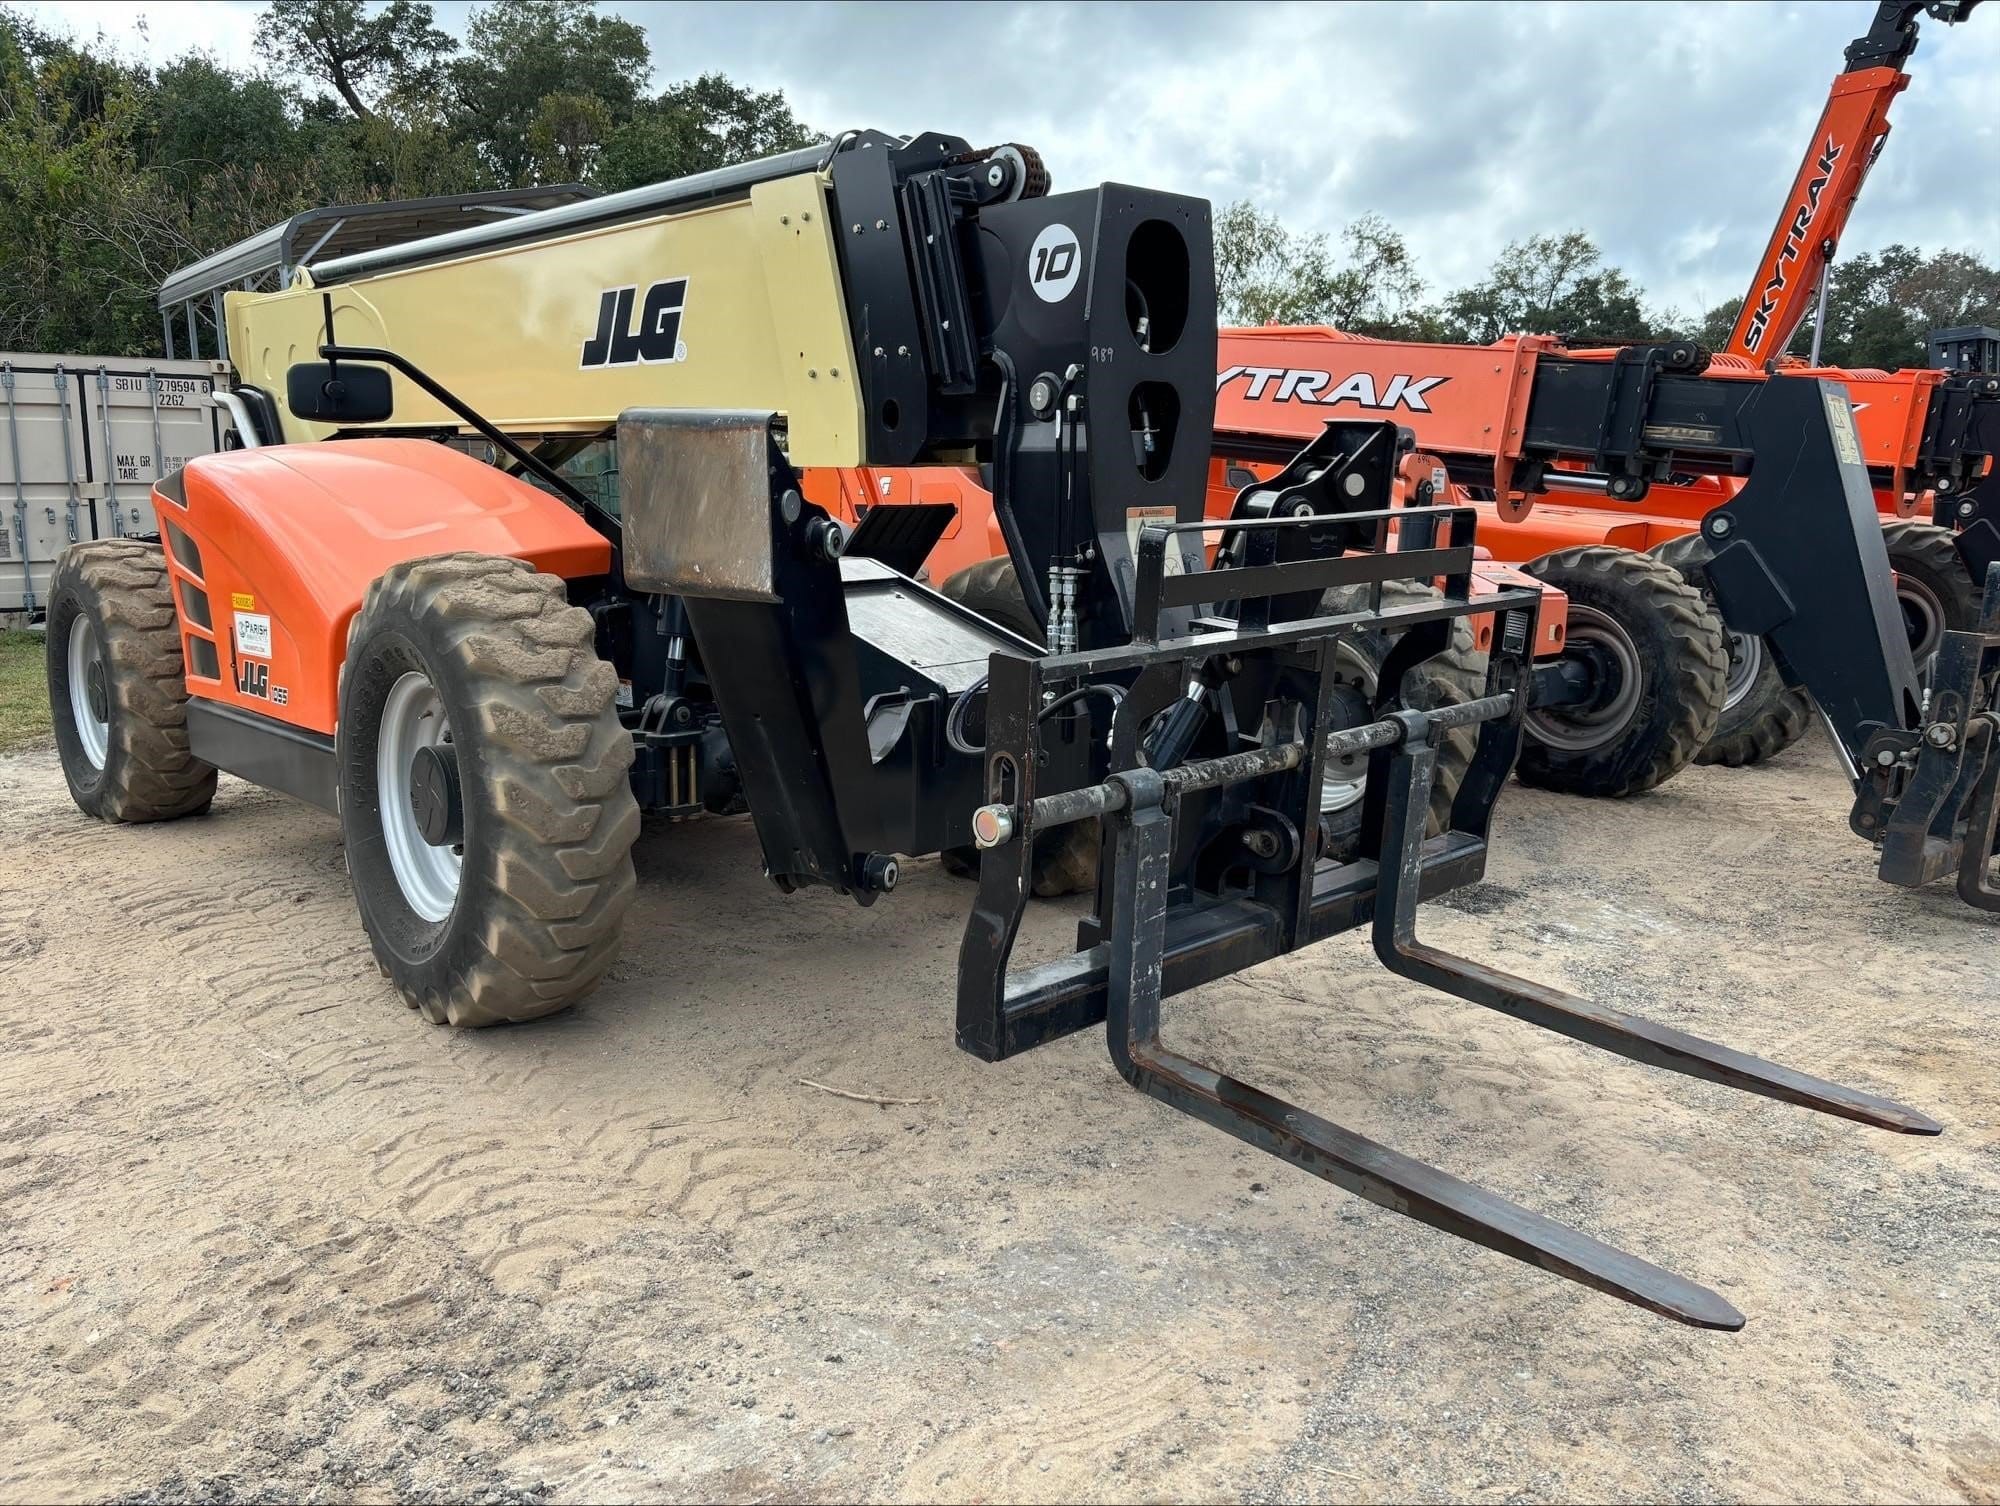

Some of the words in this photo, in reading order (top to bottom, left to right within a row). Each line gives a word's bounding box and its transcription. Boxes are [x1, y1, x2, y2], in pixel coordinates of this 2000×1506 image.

[1744, 133, 1844, 355] SKYTRAK
[1033, 242, 1077, 283] 10
[580, 277, 689, 369] JLG
[1091, 346, 1114, 362] 989
[115, 378, 142, 391] SBIU
[158, 380, 196, 393] 279594
[202, 381, 208, 394] 6
[159, 394, 185, 407] 22G2
[118, 468, 139, 480] TARE
[240, 660, 269, 699] JLG
